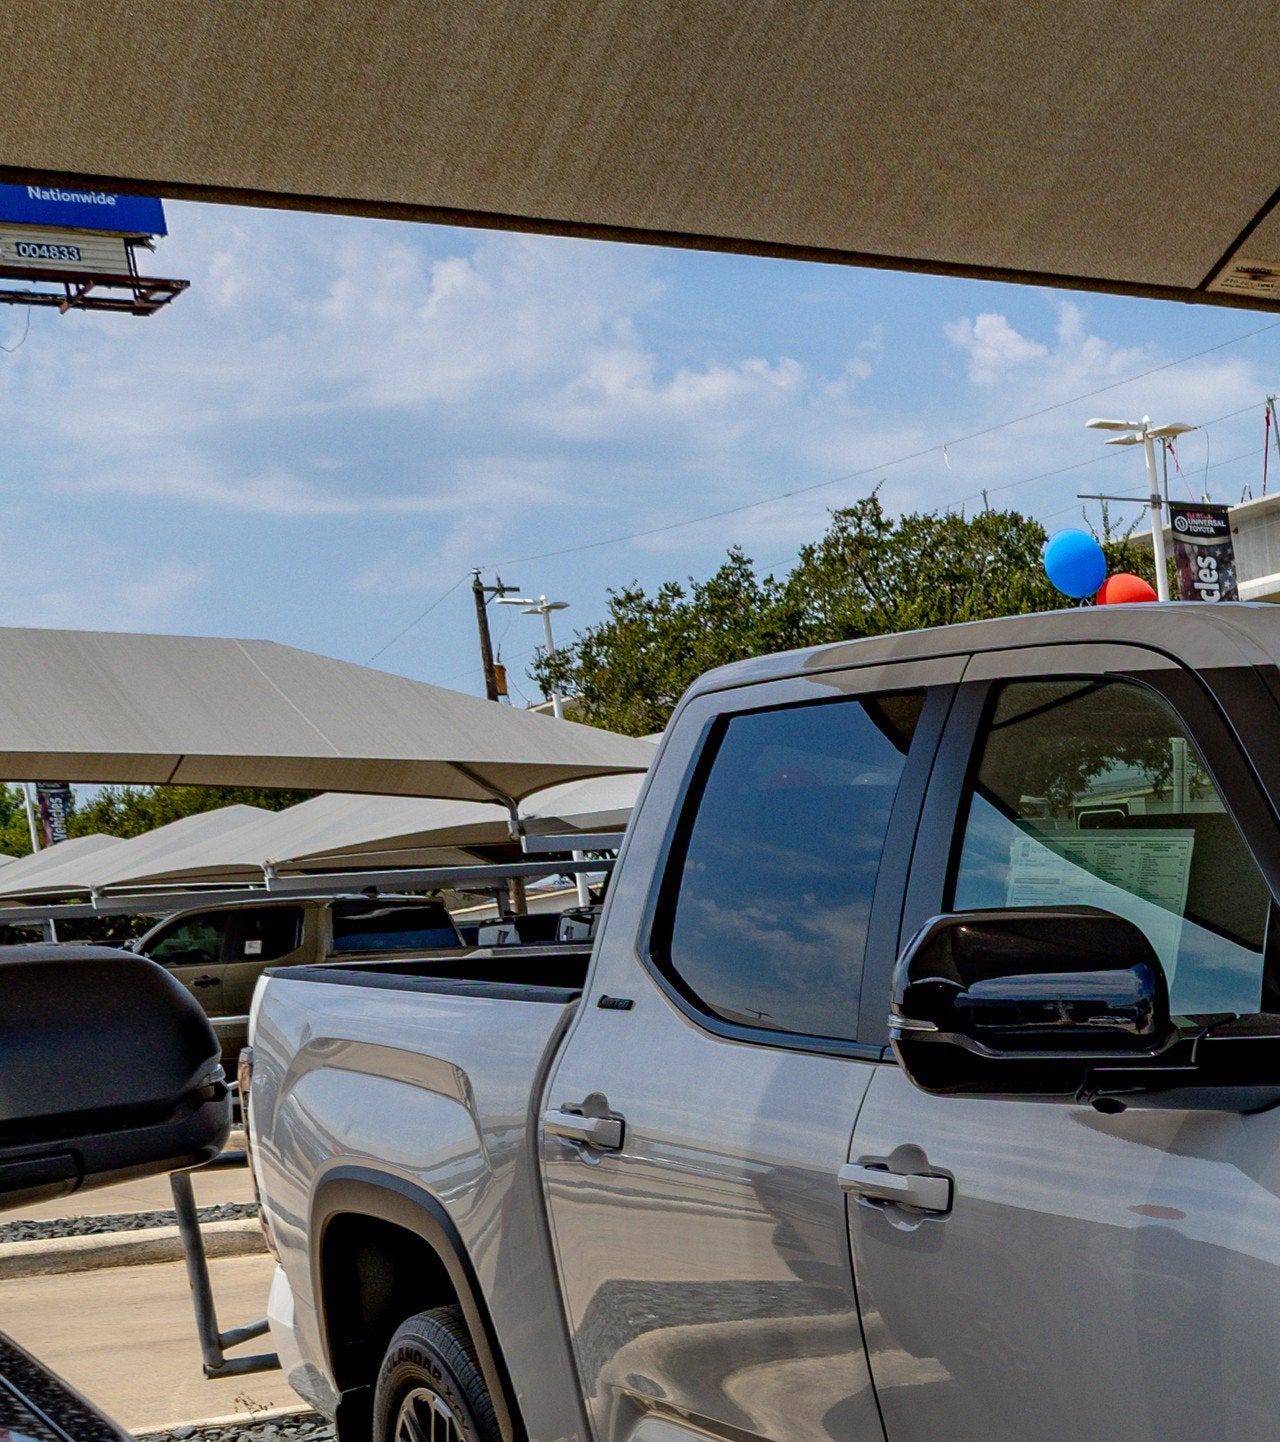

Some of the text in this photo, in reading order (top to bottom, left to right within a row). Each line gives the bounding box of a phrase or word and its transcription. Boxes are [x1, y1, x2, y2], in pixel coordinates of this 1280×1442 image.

[28, 186, 117, 206] Nationwide
[19, 243, 79, 261] 004833
[1188, 518, 1226, 528] UNIVERSAL
[1189, 526, 1215, 534] TOYOTA
